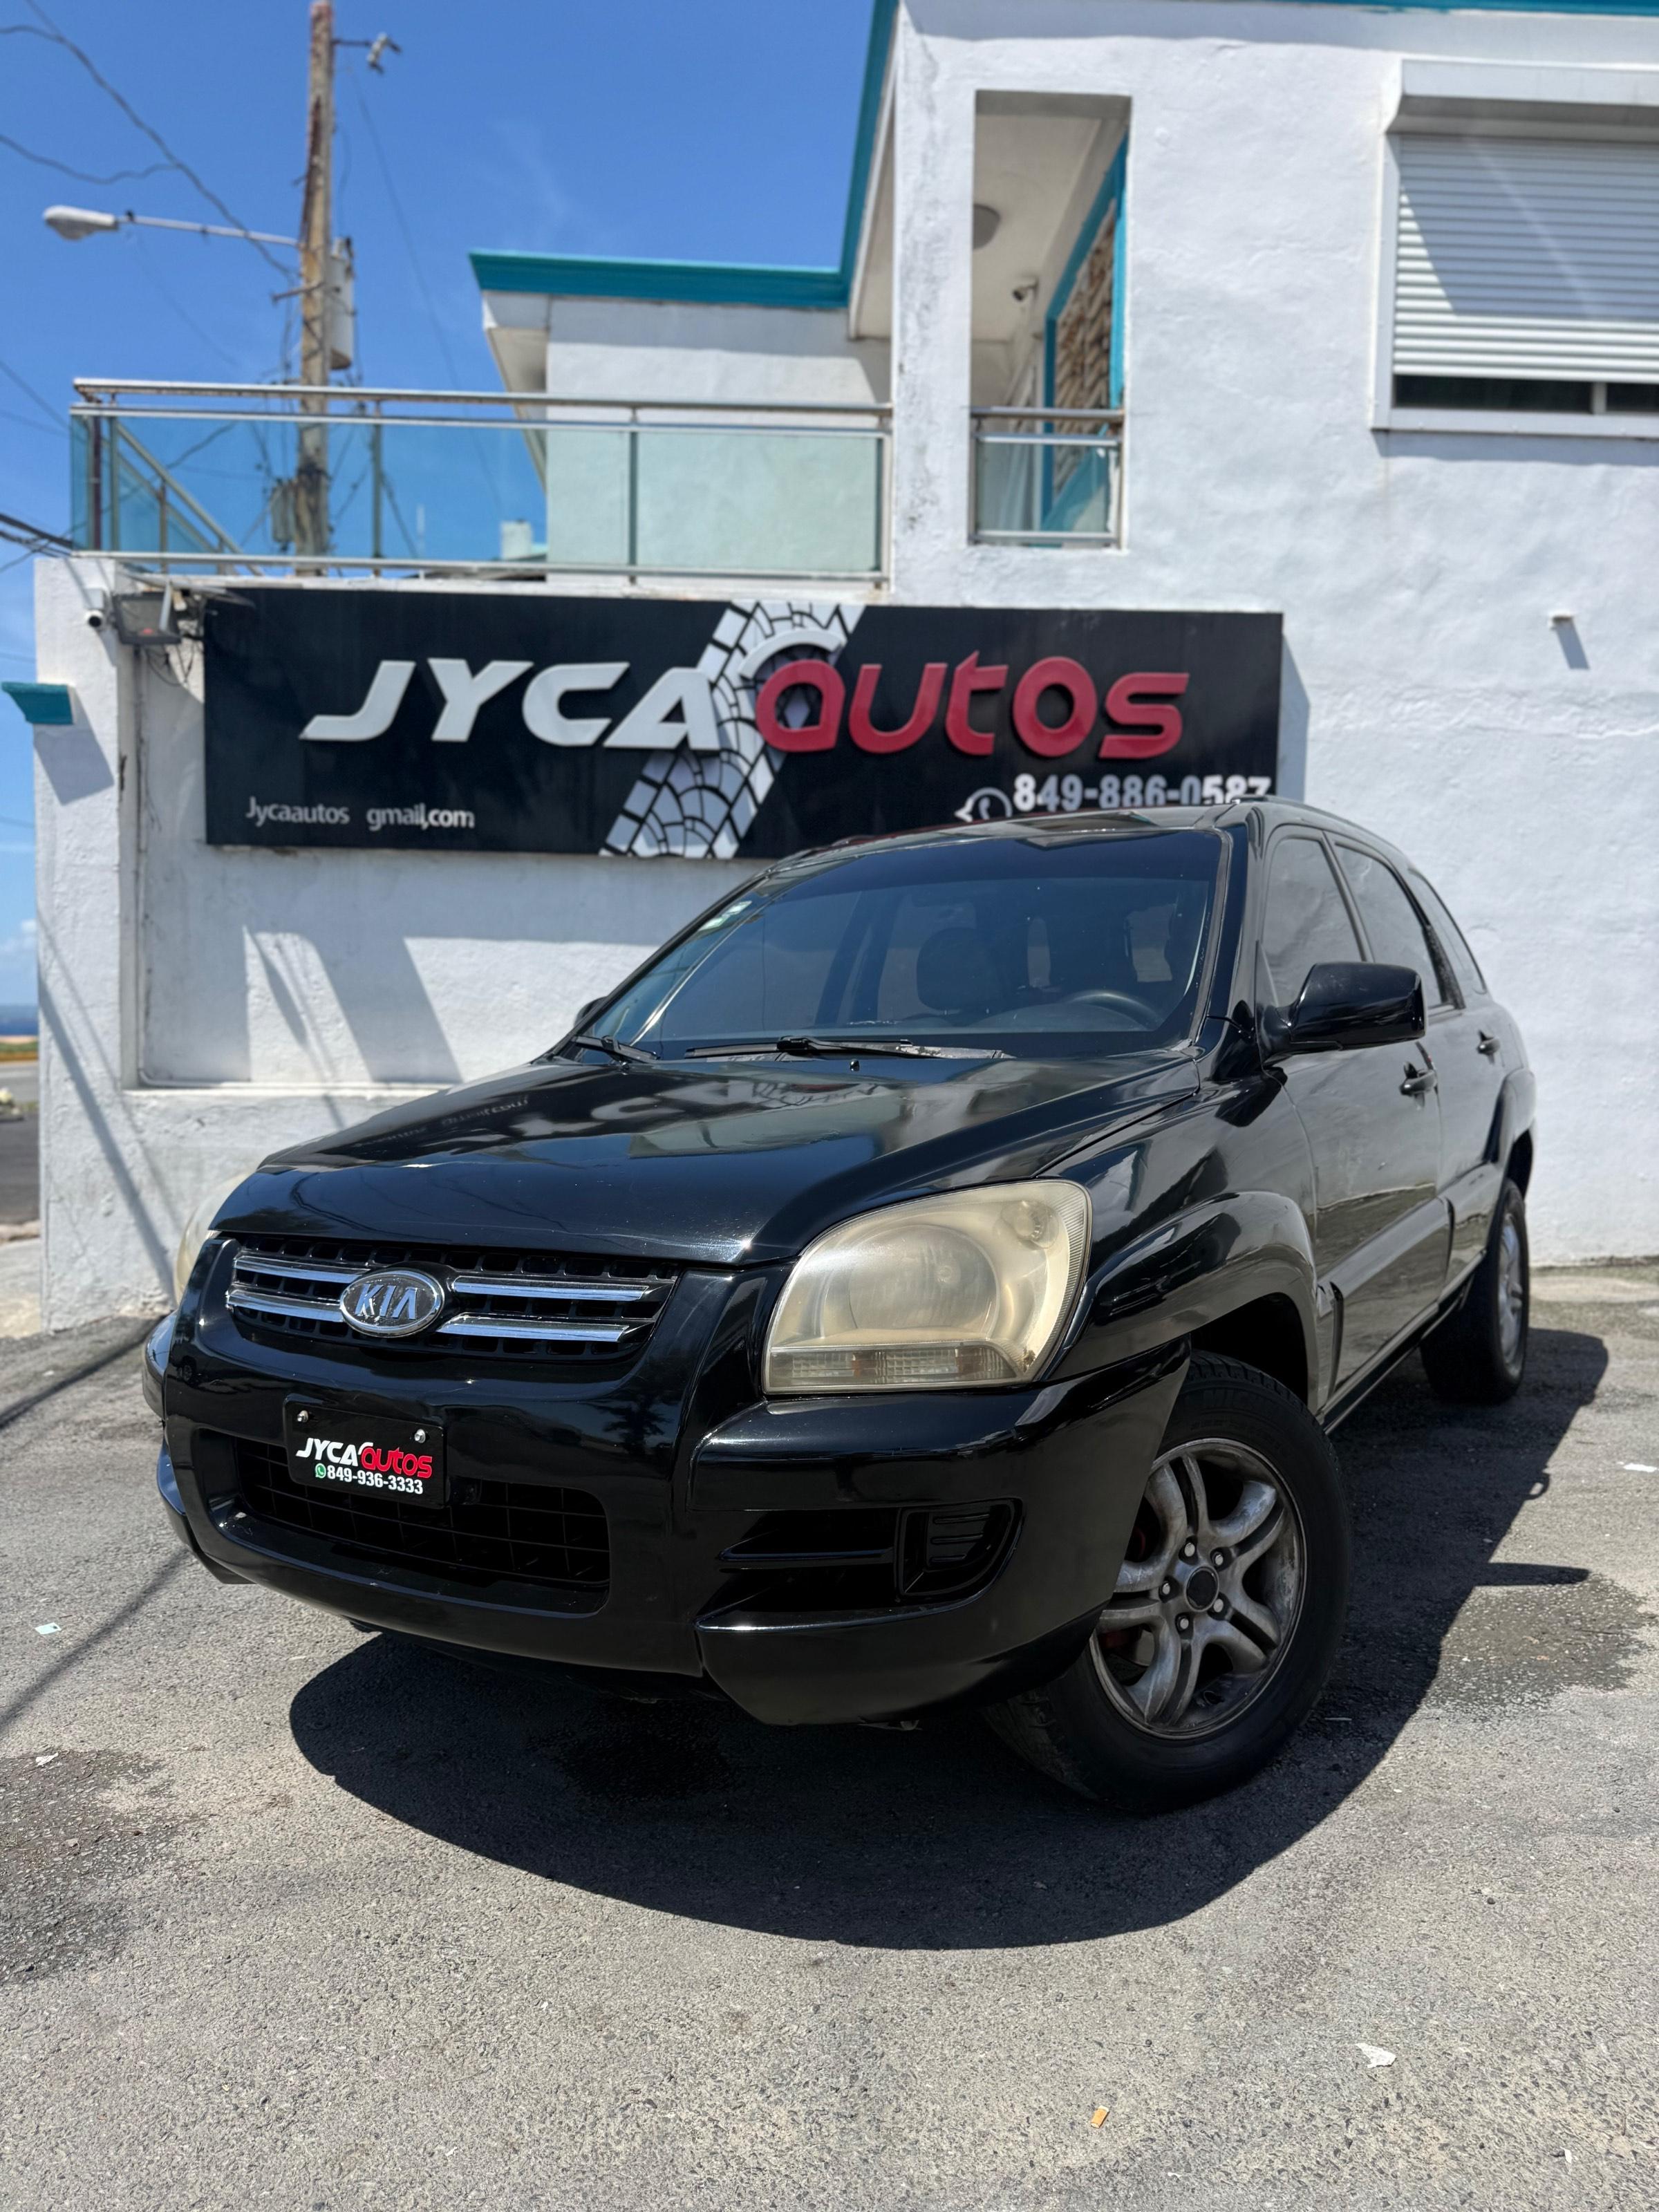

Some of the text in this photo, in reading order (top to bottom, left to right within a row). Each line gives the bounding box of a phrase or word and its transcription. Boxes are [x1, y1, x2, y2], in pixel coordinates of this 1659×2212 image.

[245, 796, 350, 827] Jycaautos
[355, 1283, 418, 1320] KIA
[327, 1465, 423, 1494] 849-936-3333
